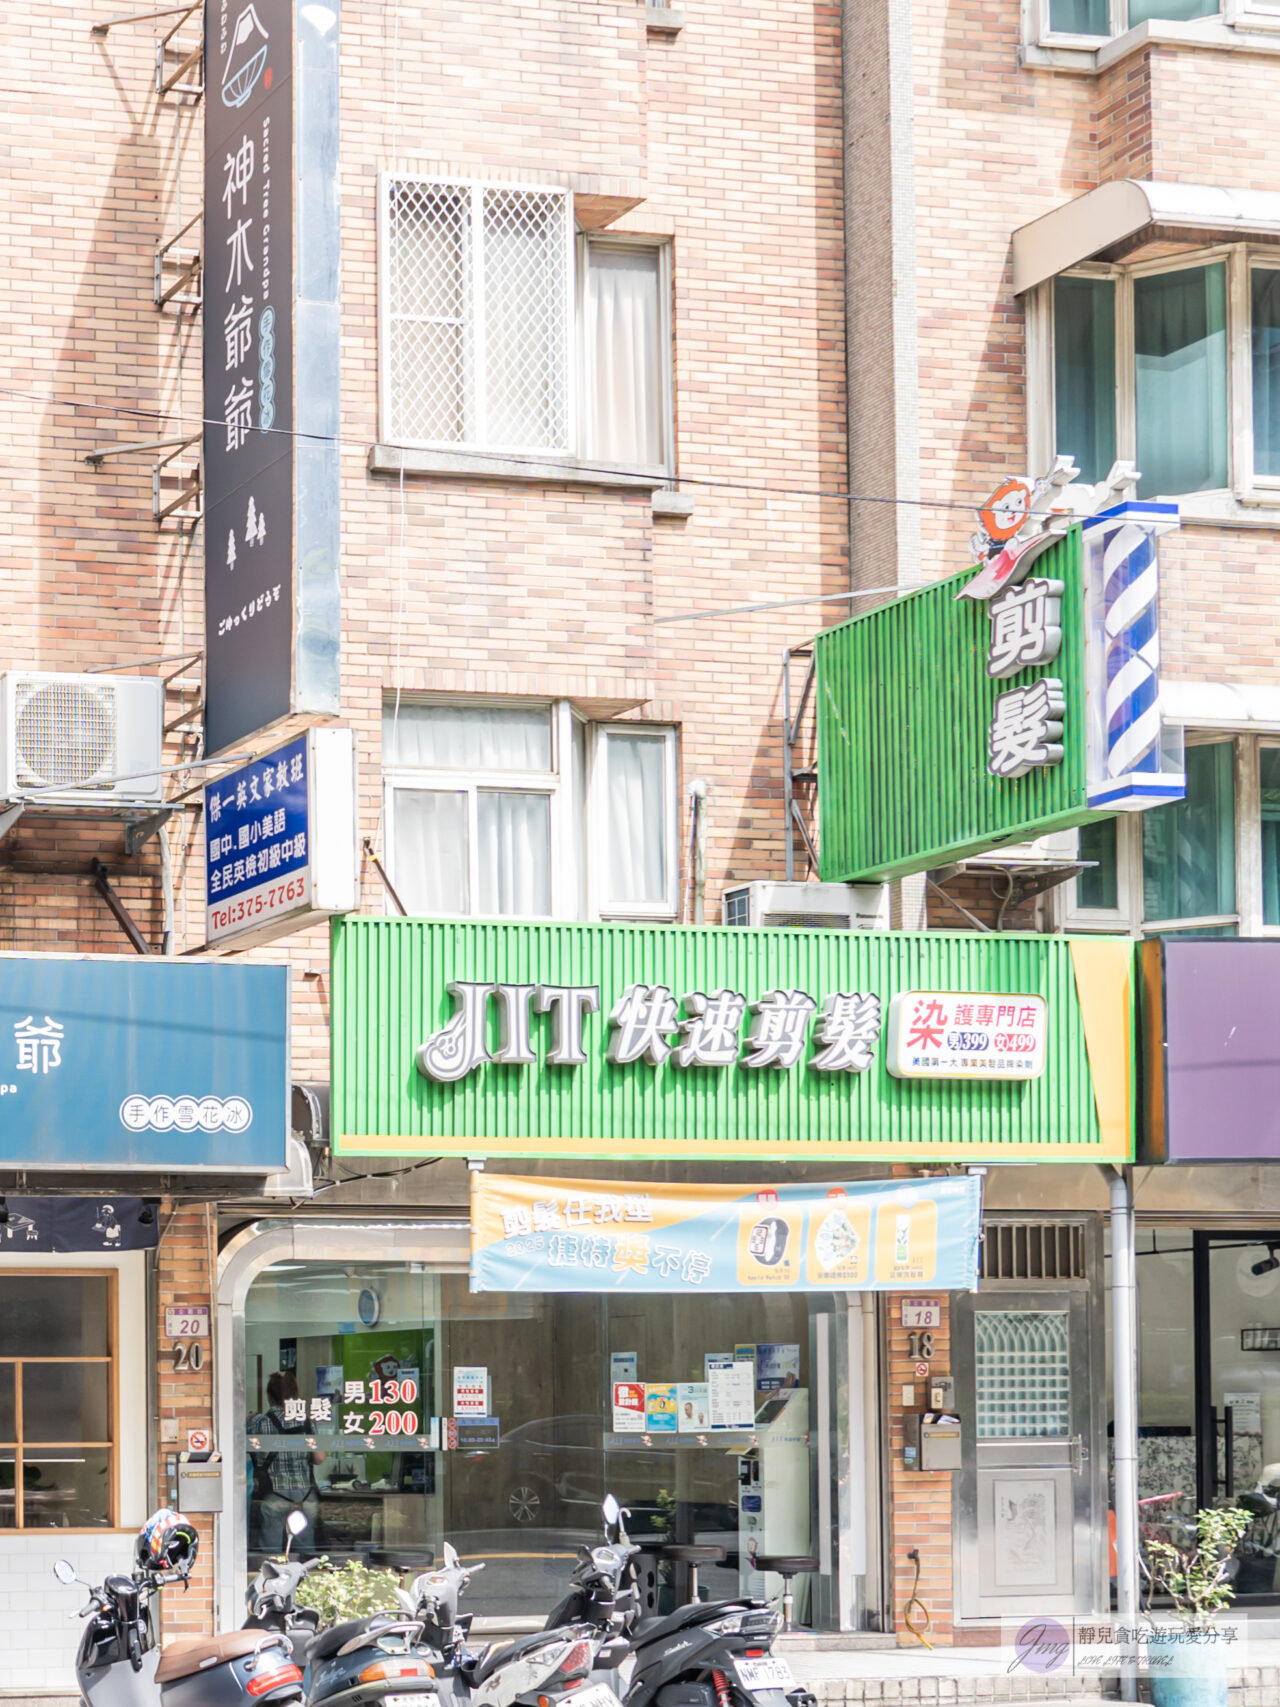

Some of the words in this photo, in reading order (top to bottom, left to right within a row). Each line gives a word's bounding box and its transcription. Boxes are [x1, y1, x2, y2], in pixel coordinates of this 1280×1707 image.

[262, 116, 271, 175] Sacred
[262, 178, 270, 222] Tree
[262, 223, 271, 301] Grandpa
[222, 134, 255, 453] 神木爺爺
[218, 584, 281, 636] ごゆっくりどうぞ
[987, 577, 1065, 779] 剪髮
[210, 832, 307, 894] 全民英檢初級中級
[211, 877, 305, 930] Tel:375-7763
[608, 983, 882, 1074] 快速剪髮
[127, 1103, 244, 1125] 手作雪花冰
[180, 1319, 200, 1335] 20
[914, 1310, 933, 1325] 18
[174, 1342, 204, 1371] 20
[908, 1332, 935, 1359] 18
[283, 1397, 332, 1422] 剪髮
